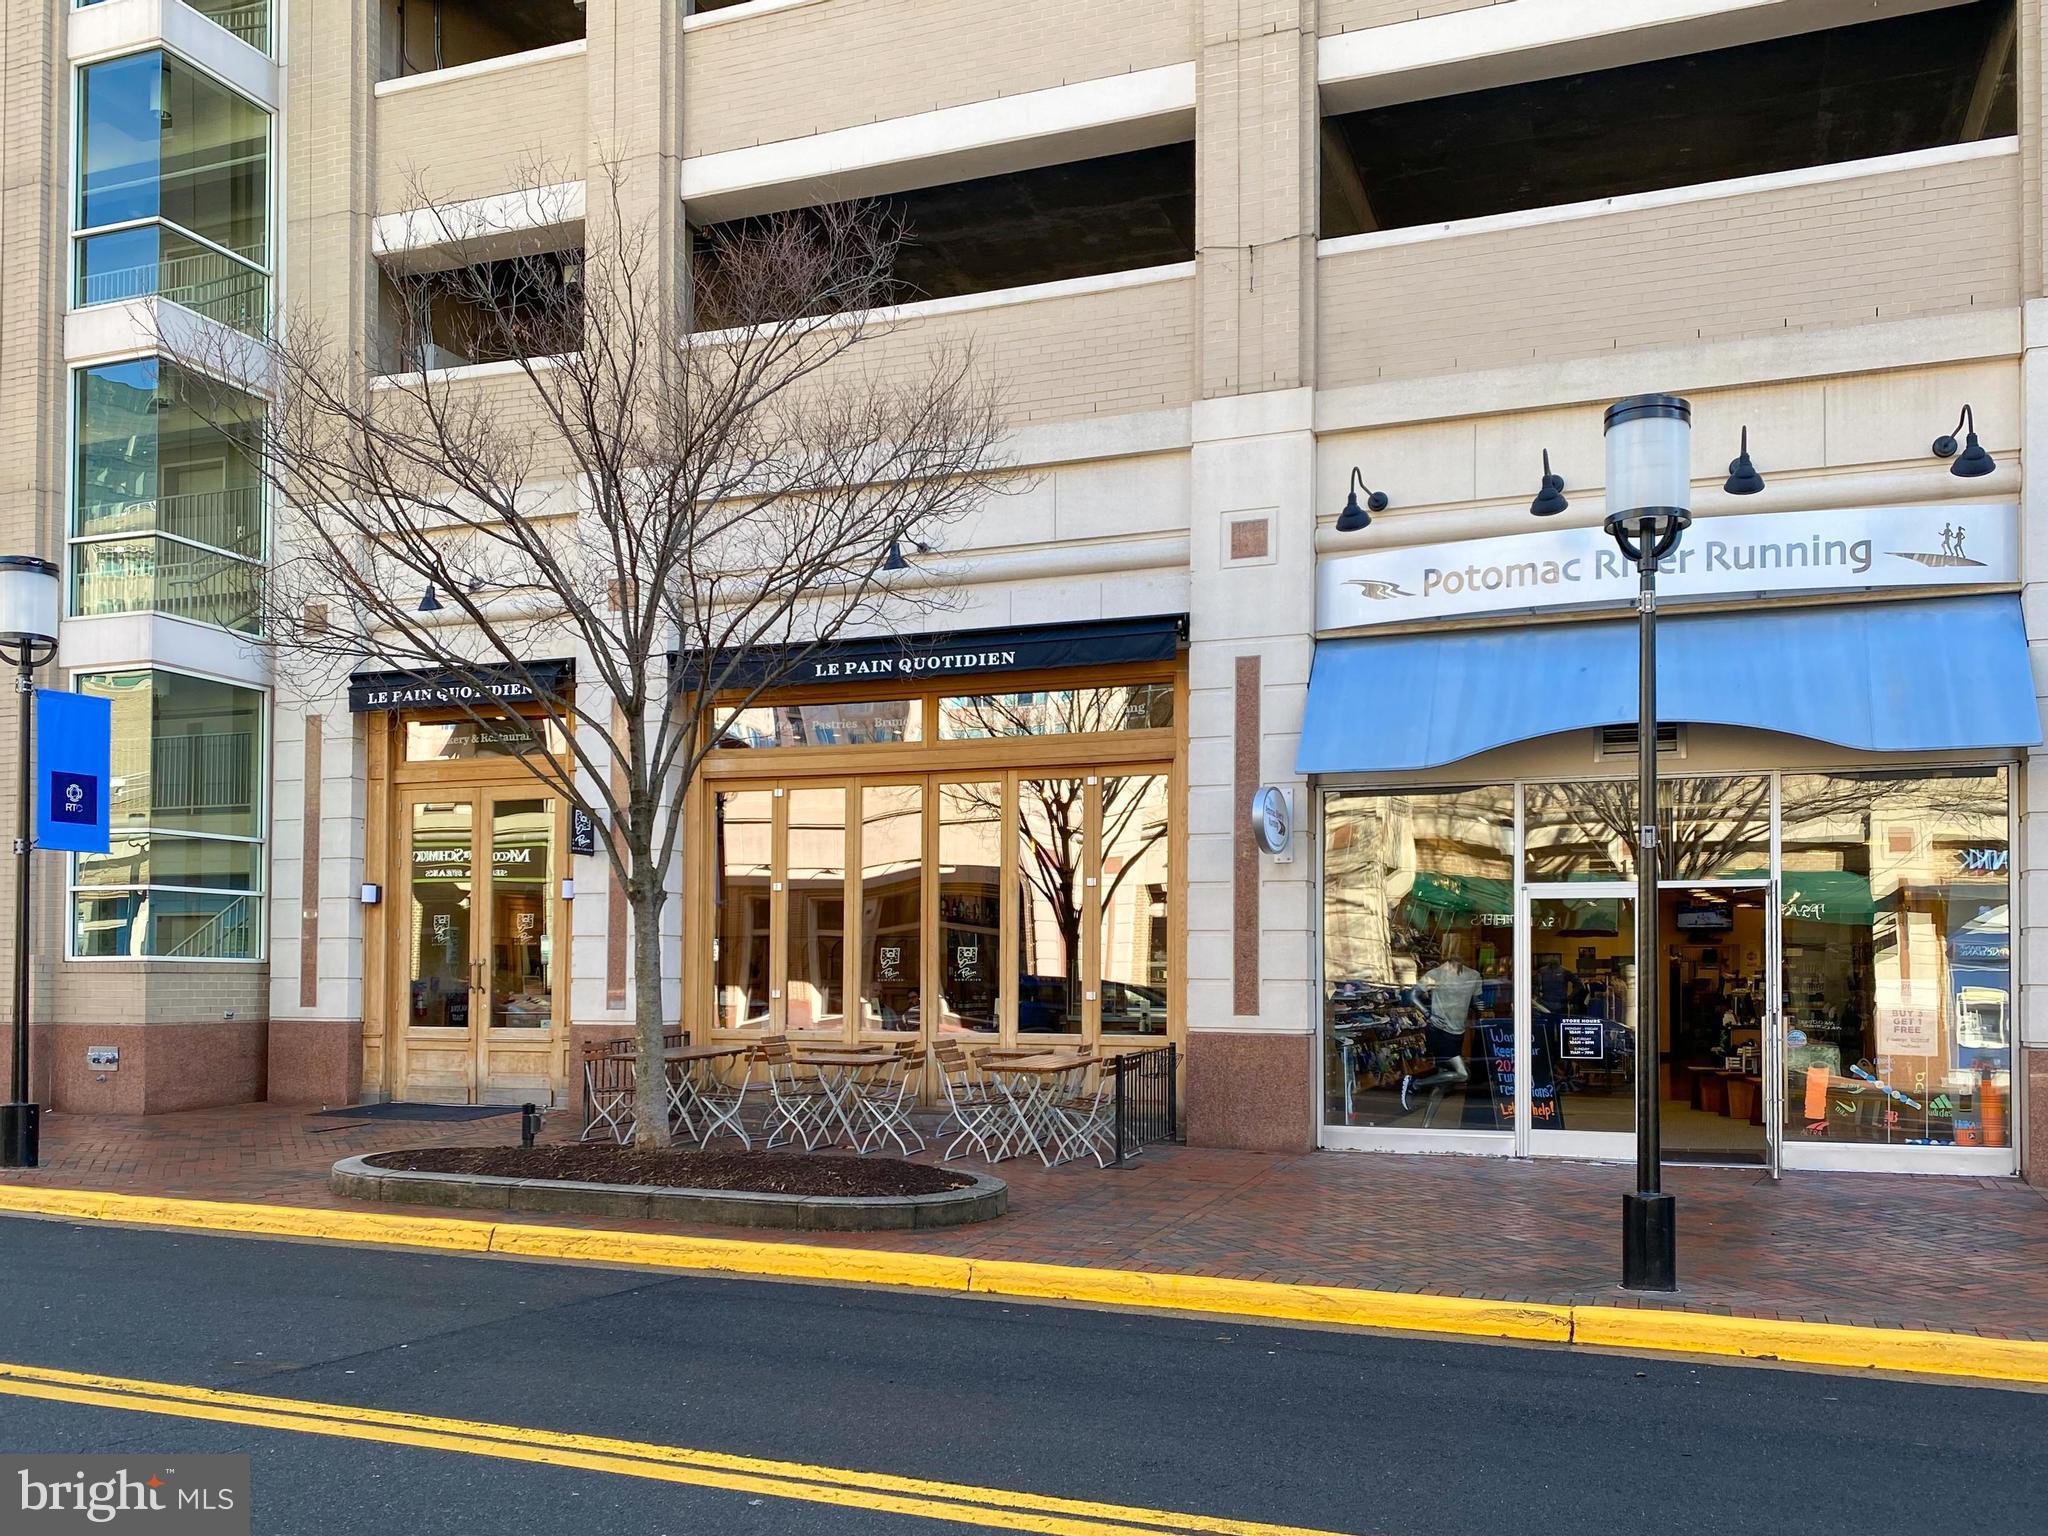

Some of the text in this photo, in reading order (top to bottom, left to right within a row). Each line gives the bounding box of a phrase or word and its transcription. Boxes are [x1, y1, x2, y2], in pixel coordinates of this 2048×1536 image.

[1424, 534, 1873, 597] Potomac Rier Running
[814, 650, 1017, 678] LE PAIN QUOTIDIEN
[366, 691, 389, 706] LE
[391, 686, 433, 703] PAIN
[812, 719, 858, 730] Pastries
[471, 732, 479, 743] &
[65, 803, 84, 812] RTC
